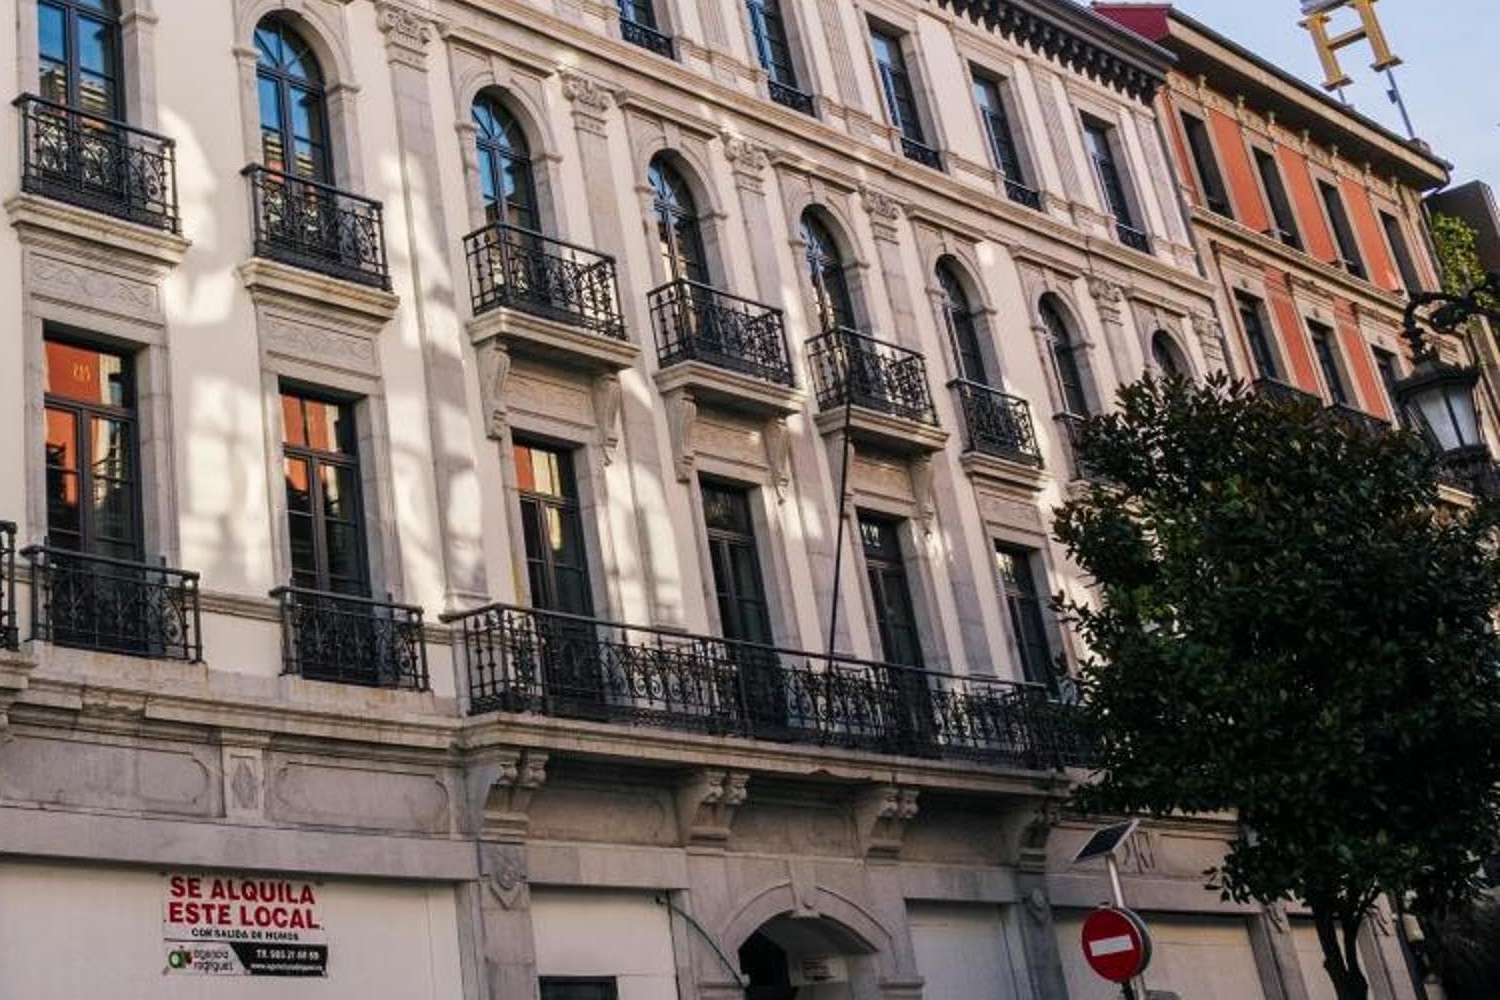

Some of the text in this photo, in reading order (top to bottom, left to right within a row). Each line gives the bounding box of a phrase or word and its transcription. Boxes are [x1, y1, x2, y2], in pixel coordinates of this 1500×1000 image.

[170, 876, 315, 905] SE ALQUILA
[169, 902, 320, 929] ESTE LOCAL
[191, 927, 299, 941] CON SALIDA DE HUMOS
